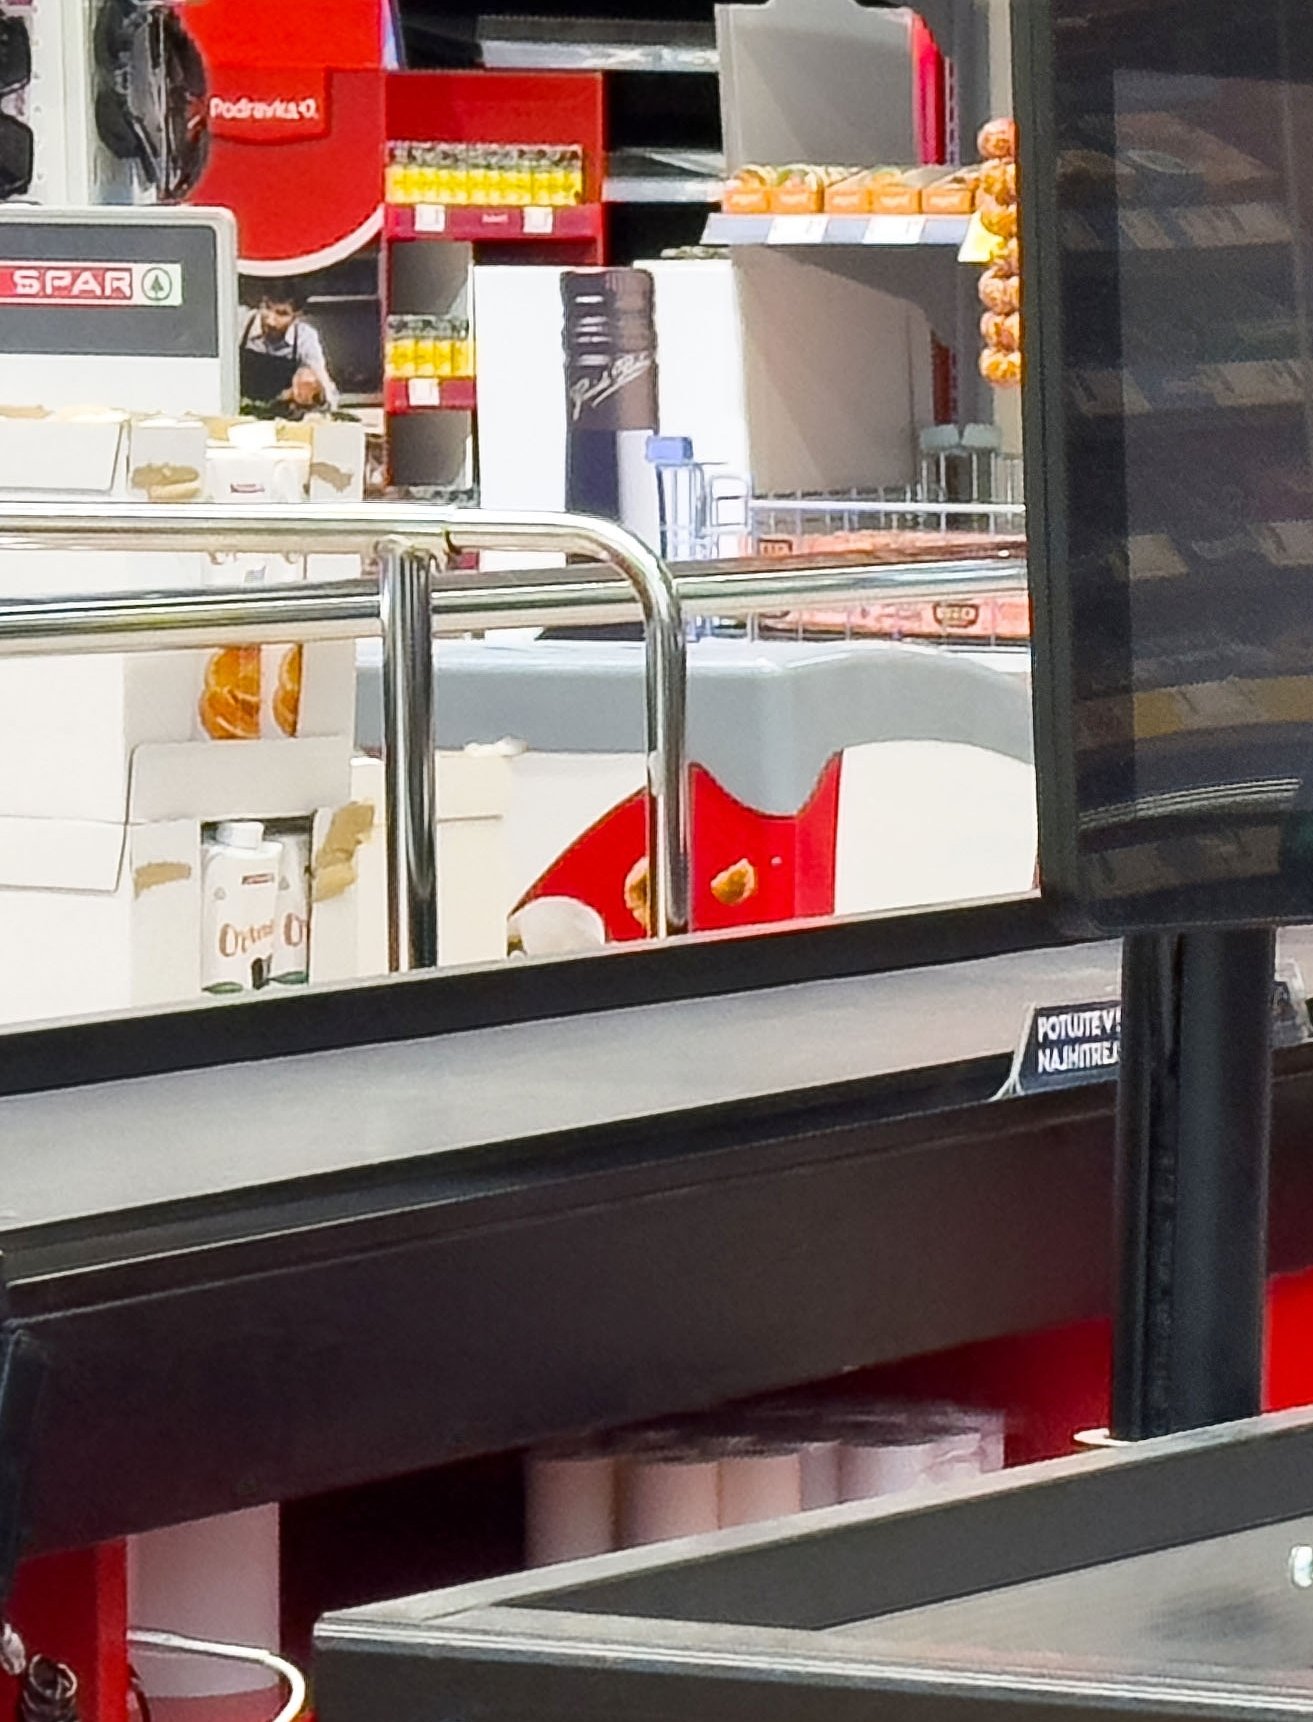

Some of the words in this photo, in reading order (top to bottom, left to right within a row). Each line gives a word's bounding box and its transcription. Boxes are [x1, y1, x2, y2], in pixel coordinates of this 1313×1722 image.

[210, 97, 299, 120] Podravka
[13, 269, 131, 297] SPAR
[1038, 1040, 1121, 1074] NAJHITREJ
